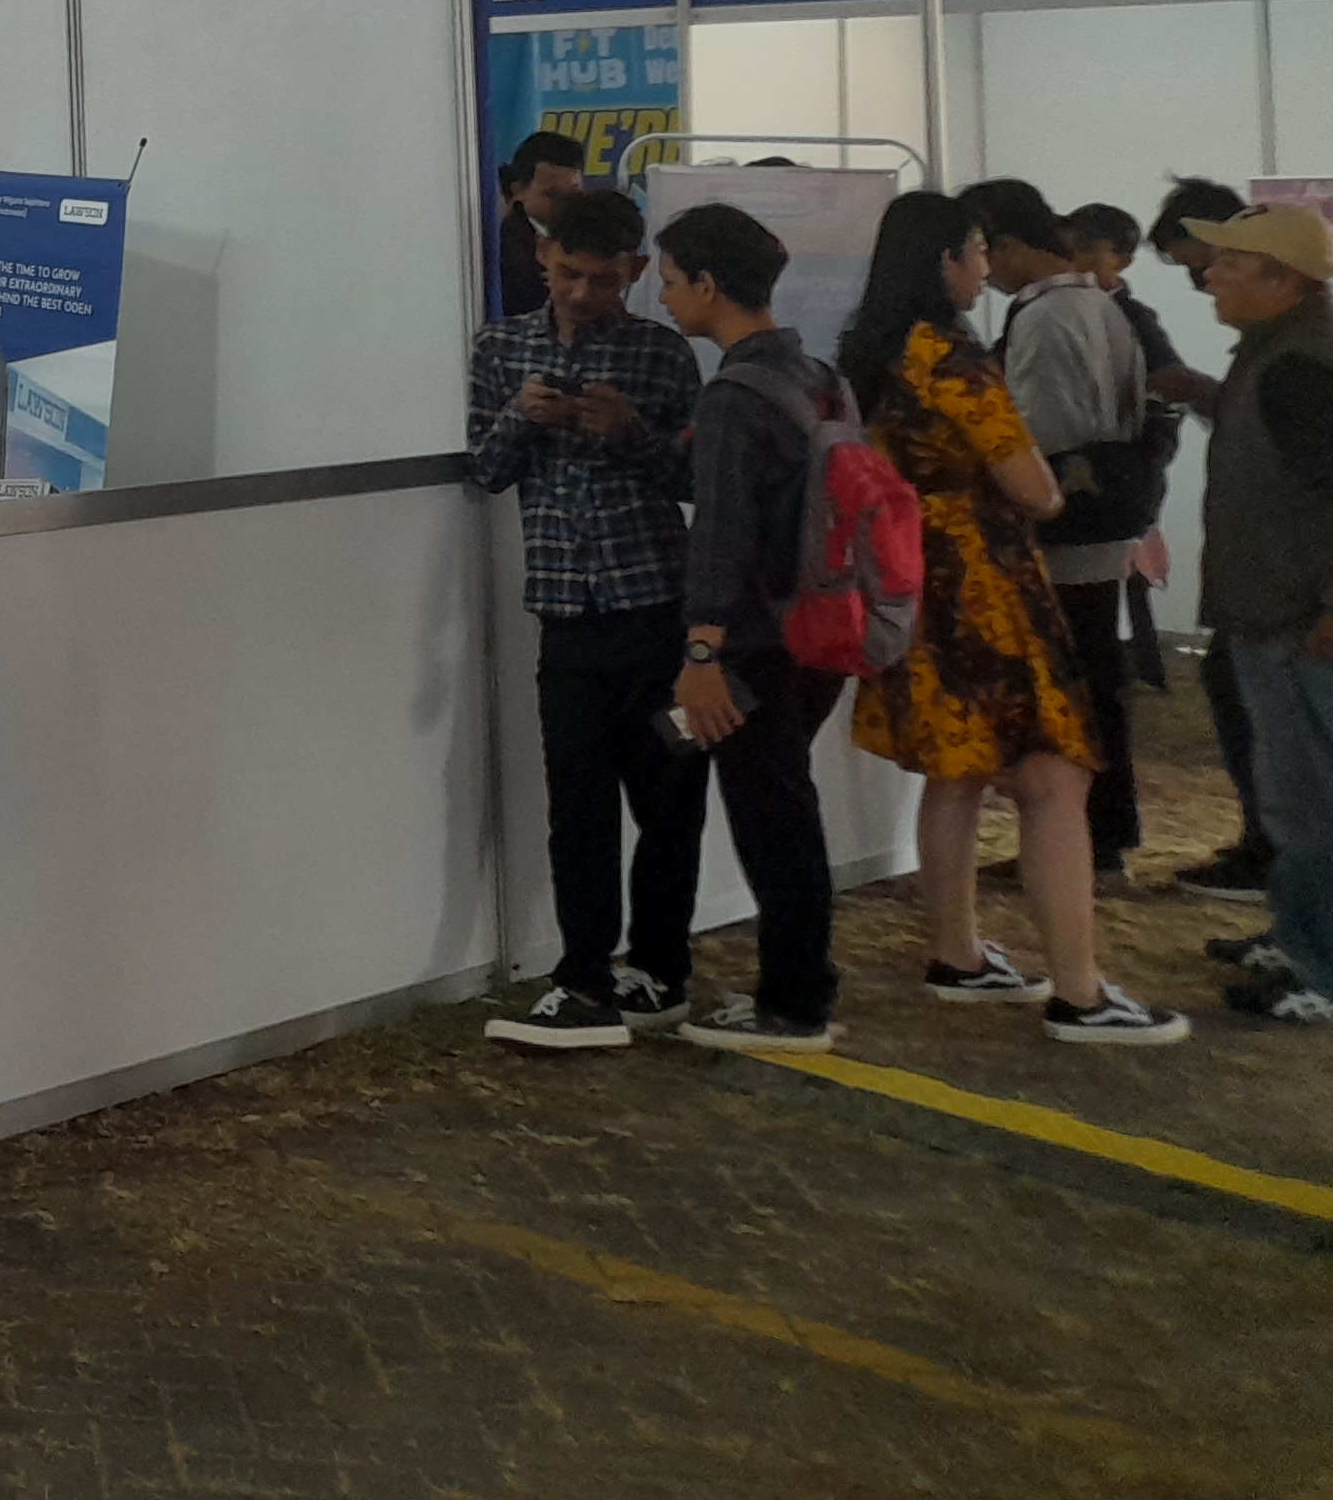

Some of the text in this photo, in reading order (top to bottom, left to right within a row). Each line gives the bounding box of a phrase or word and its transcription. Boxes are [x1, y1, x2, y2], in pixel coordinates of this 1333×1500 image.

[538, 57, 627, 91] HUB
[64, 204, 104, 219] LAWSON
[15, 263, 36, 276] TIME
[38, 266, 51, 278] TO
[52, 267, 81, 281] GROW
[8, 278, 83, 298] EXTRAORDINARY
[22, 294, 39, 308] THE
[41, 297, 63, 311] BEST
[63, 301, 93, 315] ODEN
